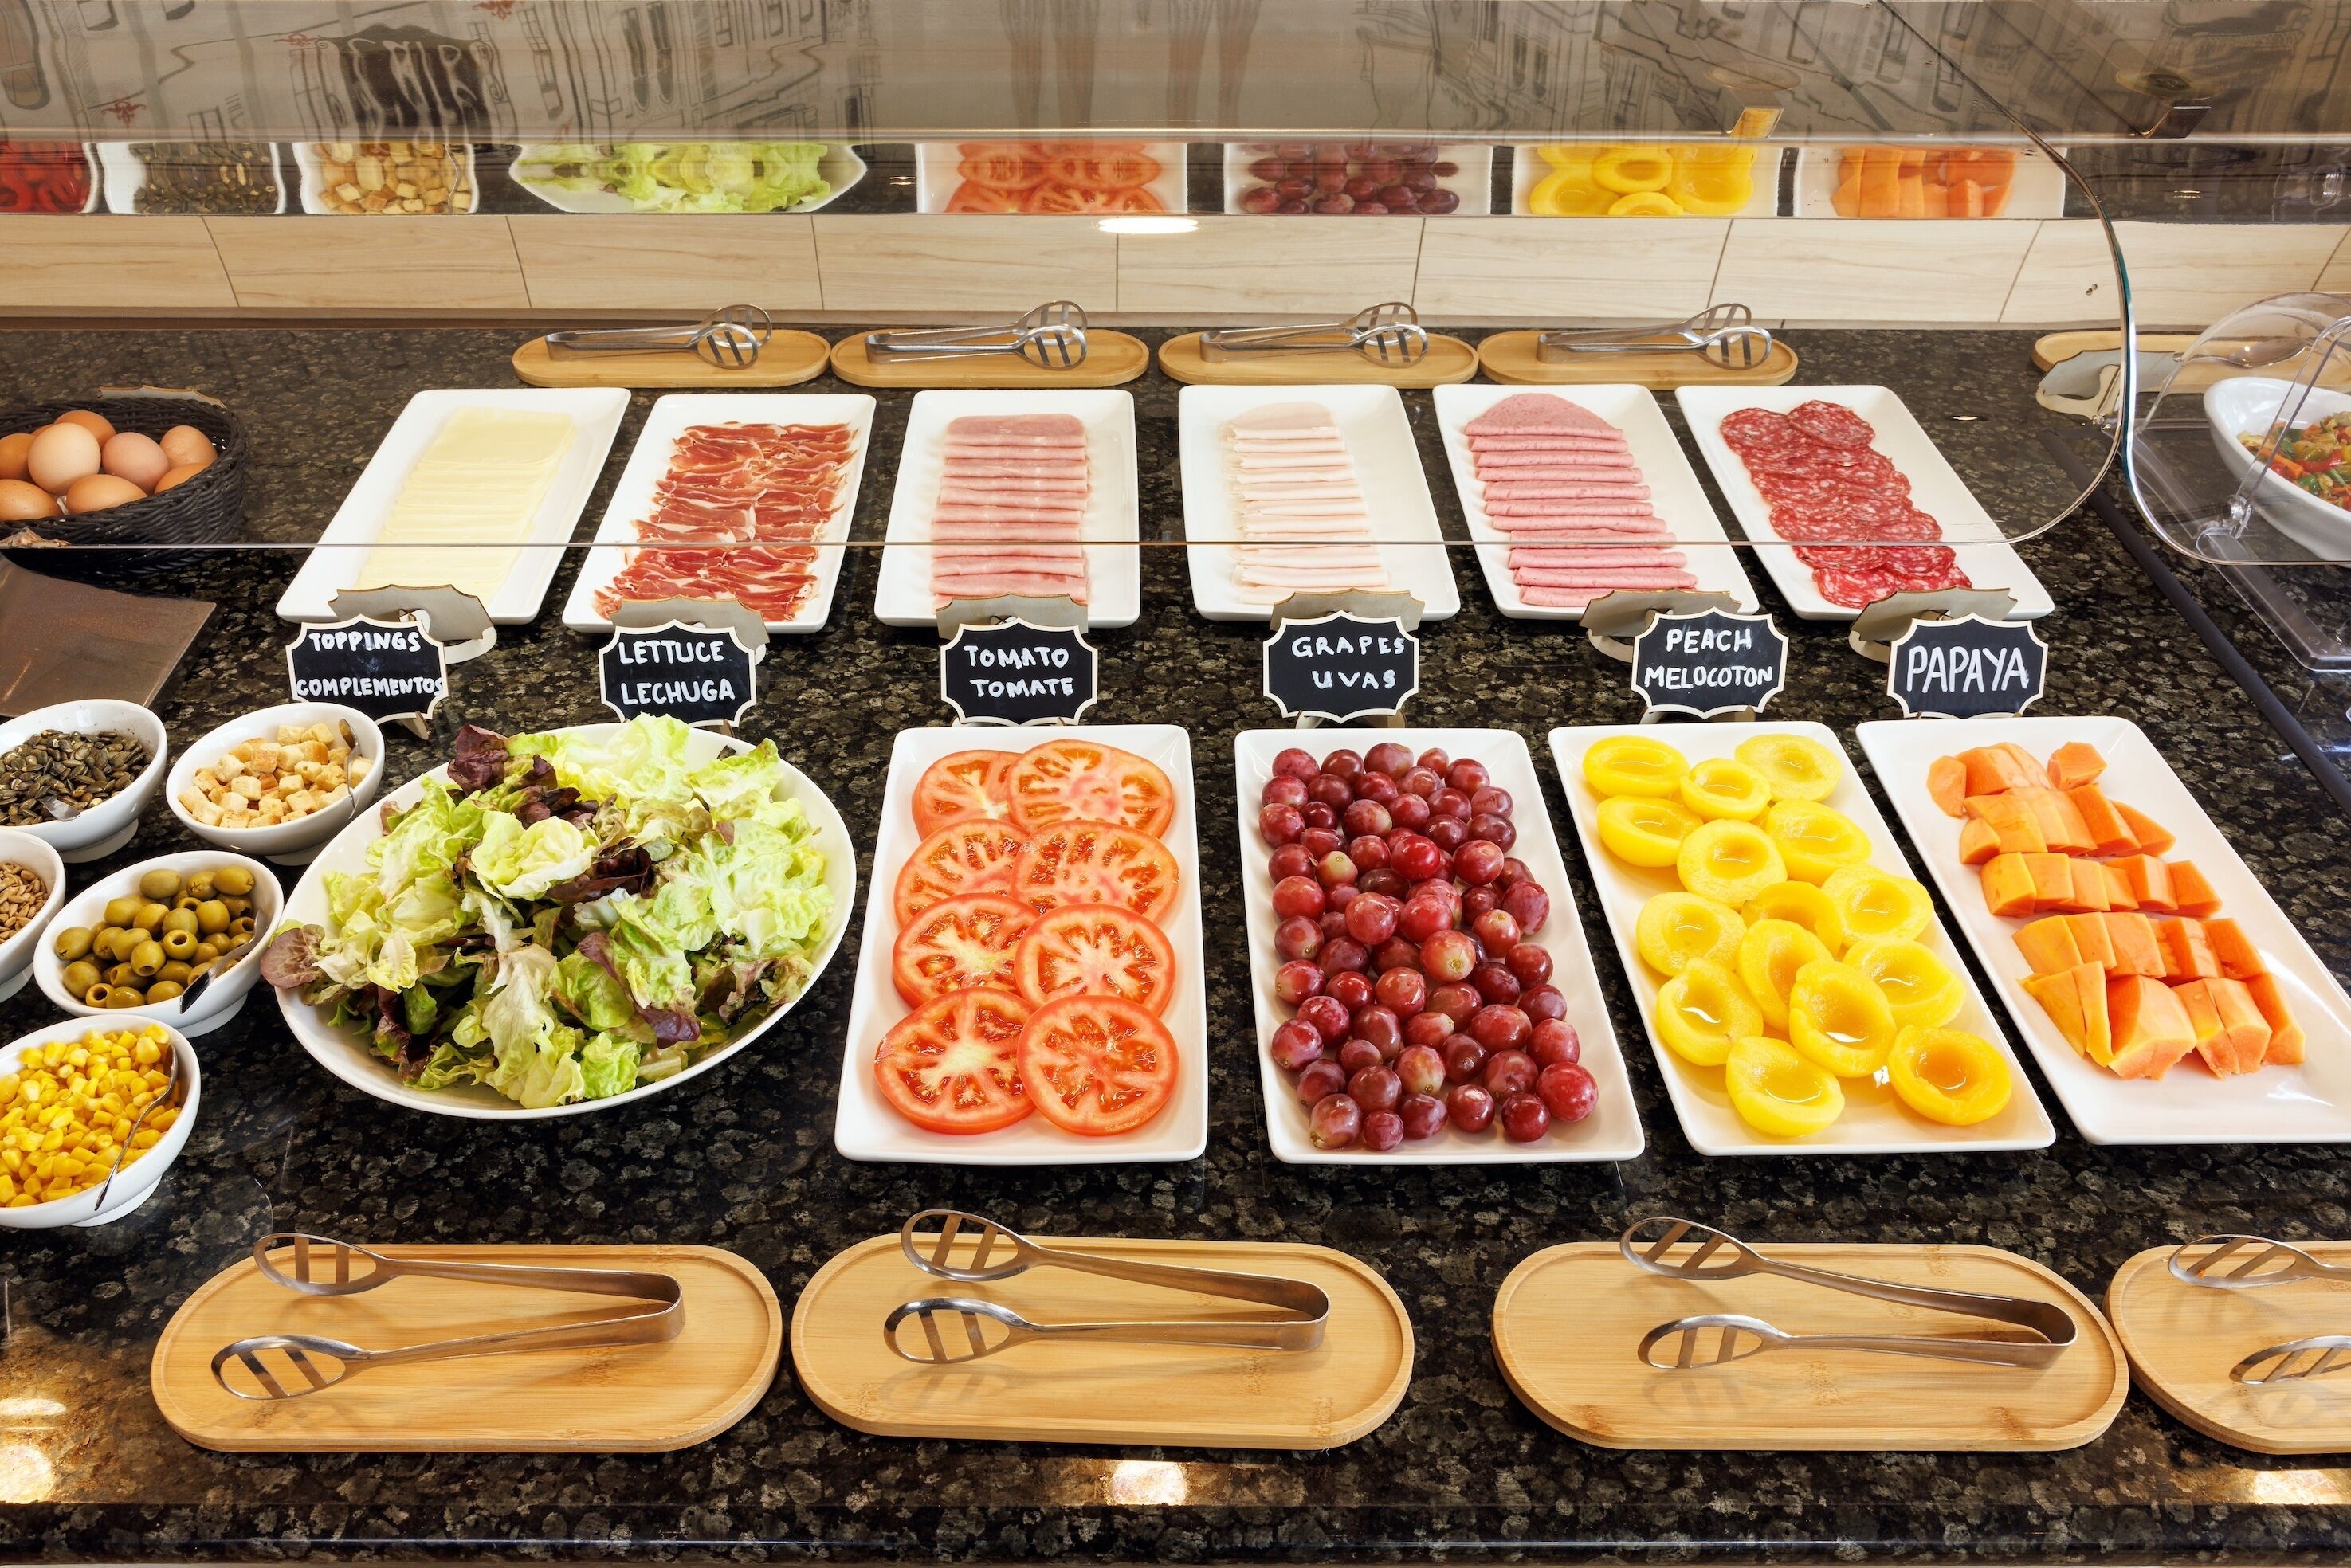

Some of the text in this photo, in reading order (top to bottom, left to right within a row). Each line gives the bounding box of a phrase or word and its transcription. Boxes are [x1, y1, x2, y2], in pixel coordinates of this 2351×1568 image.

[309, 632, 420, 652] TOPPINGS
[1292, 636, 1405, 657] GRAPES
[1666, 628, 1752, 653] PEACH
[618, 641, 724, 664] LETTUCE
[964, 645, 1069, 669] TOMATO
[1312, 670, 1396, 689] UVAS
[1644, 665, 1773, 689] MELOCOTON
[1906, 646, 2030, 693] PAPAYA
[296, 676, 445, 697] COMPLEMENTOS
[622, 679, 735, 705] LECHUGA
[970, 677, 1073, 697] TOMATE
